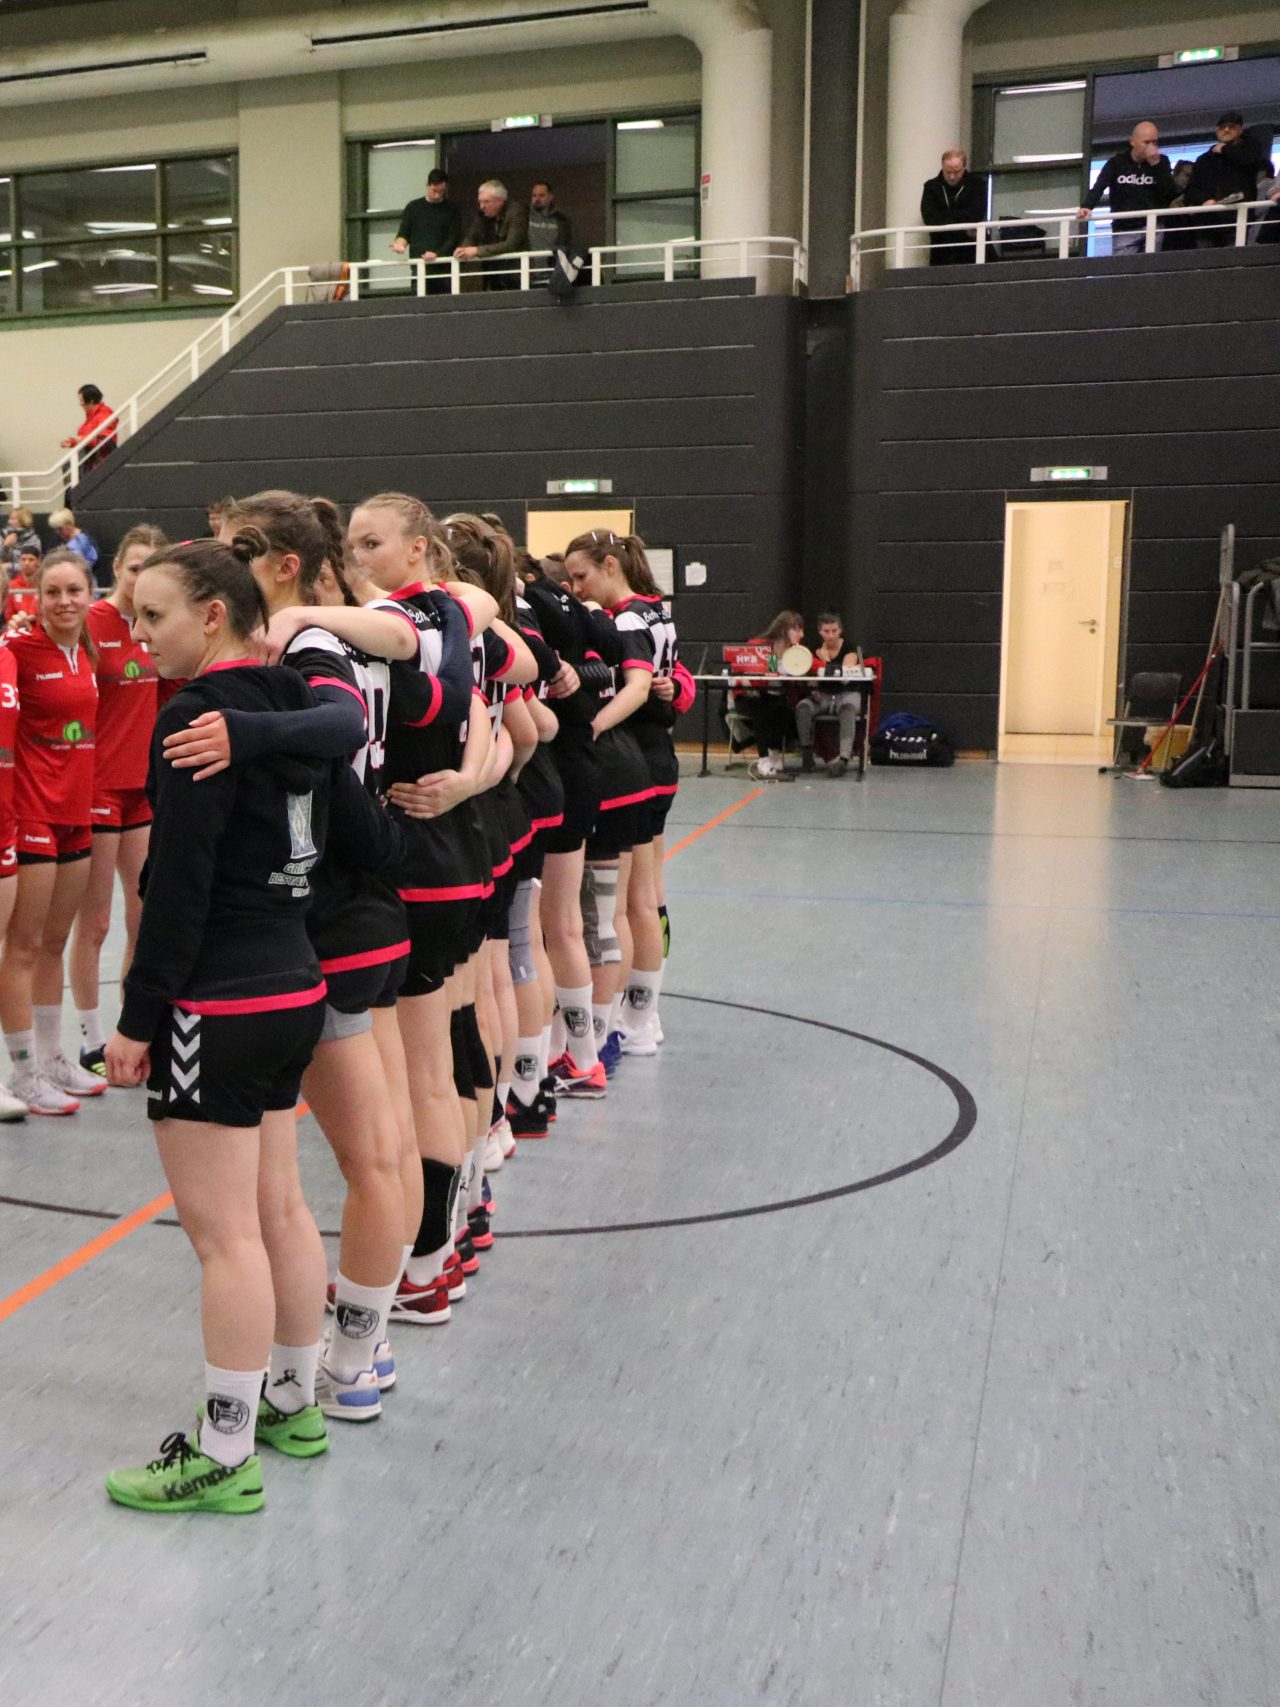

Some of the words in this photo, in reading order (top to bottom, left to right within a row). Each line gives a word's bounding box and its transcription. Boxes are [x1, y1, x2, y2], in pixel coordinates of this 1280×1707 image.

[1117, 173, 1155, 185] adida
[36, 671, 64, 680] hummel
[1, 683, 20, 710] 3
[889, 748, 927, 759] hummel
[90, 808, 111, 816] ummel
[25, 835, 51, 844] hummel
